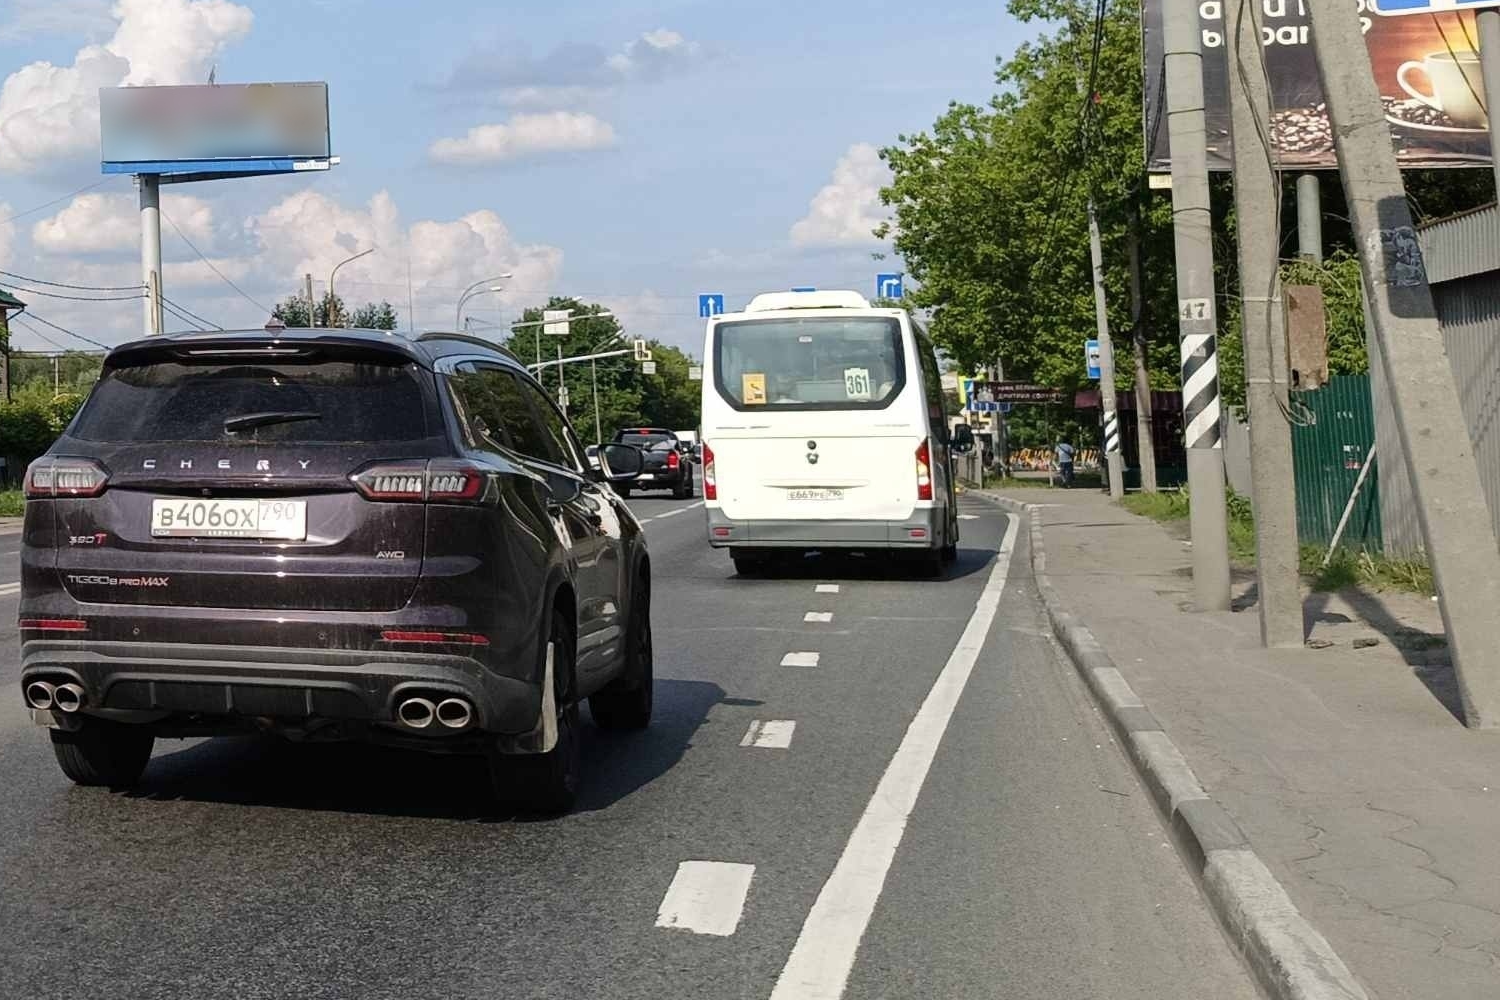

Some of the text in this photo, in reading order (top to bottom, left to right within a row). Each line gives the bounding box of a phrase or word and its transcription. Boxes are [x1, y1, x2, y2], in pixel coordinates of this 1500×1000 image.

[846, 375, 869, 395] 361
[143, 459, 311, 469] CHERY
[160, 502, 297, 527] В406ОХ 790
[376, 550, 405, 559] AWD
